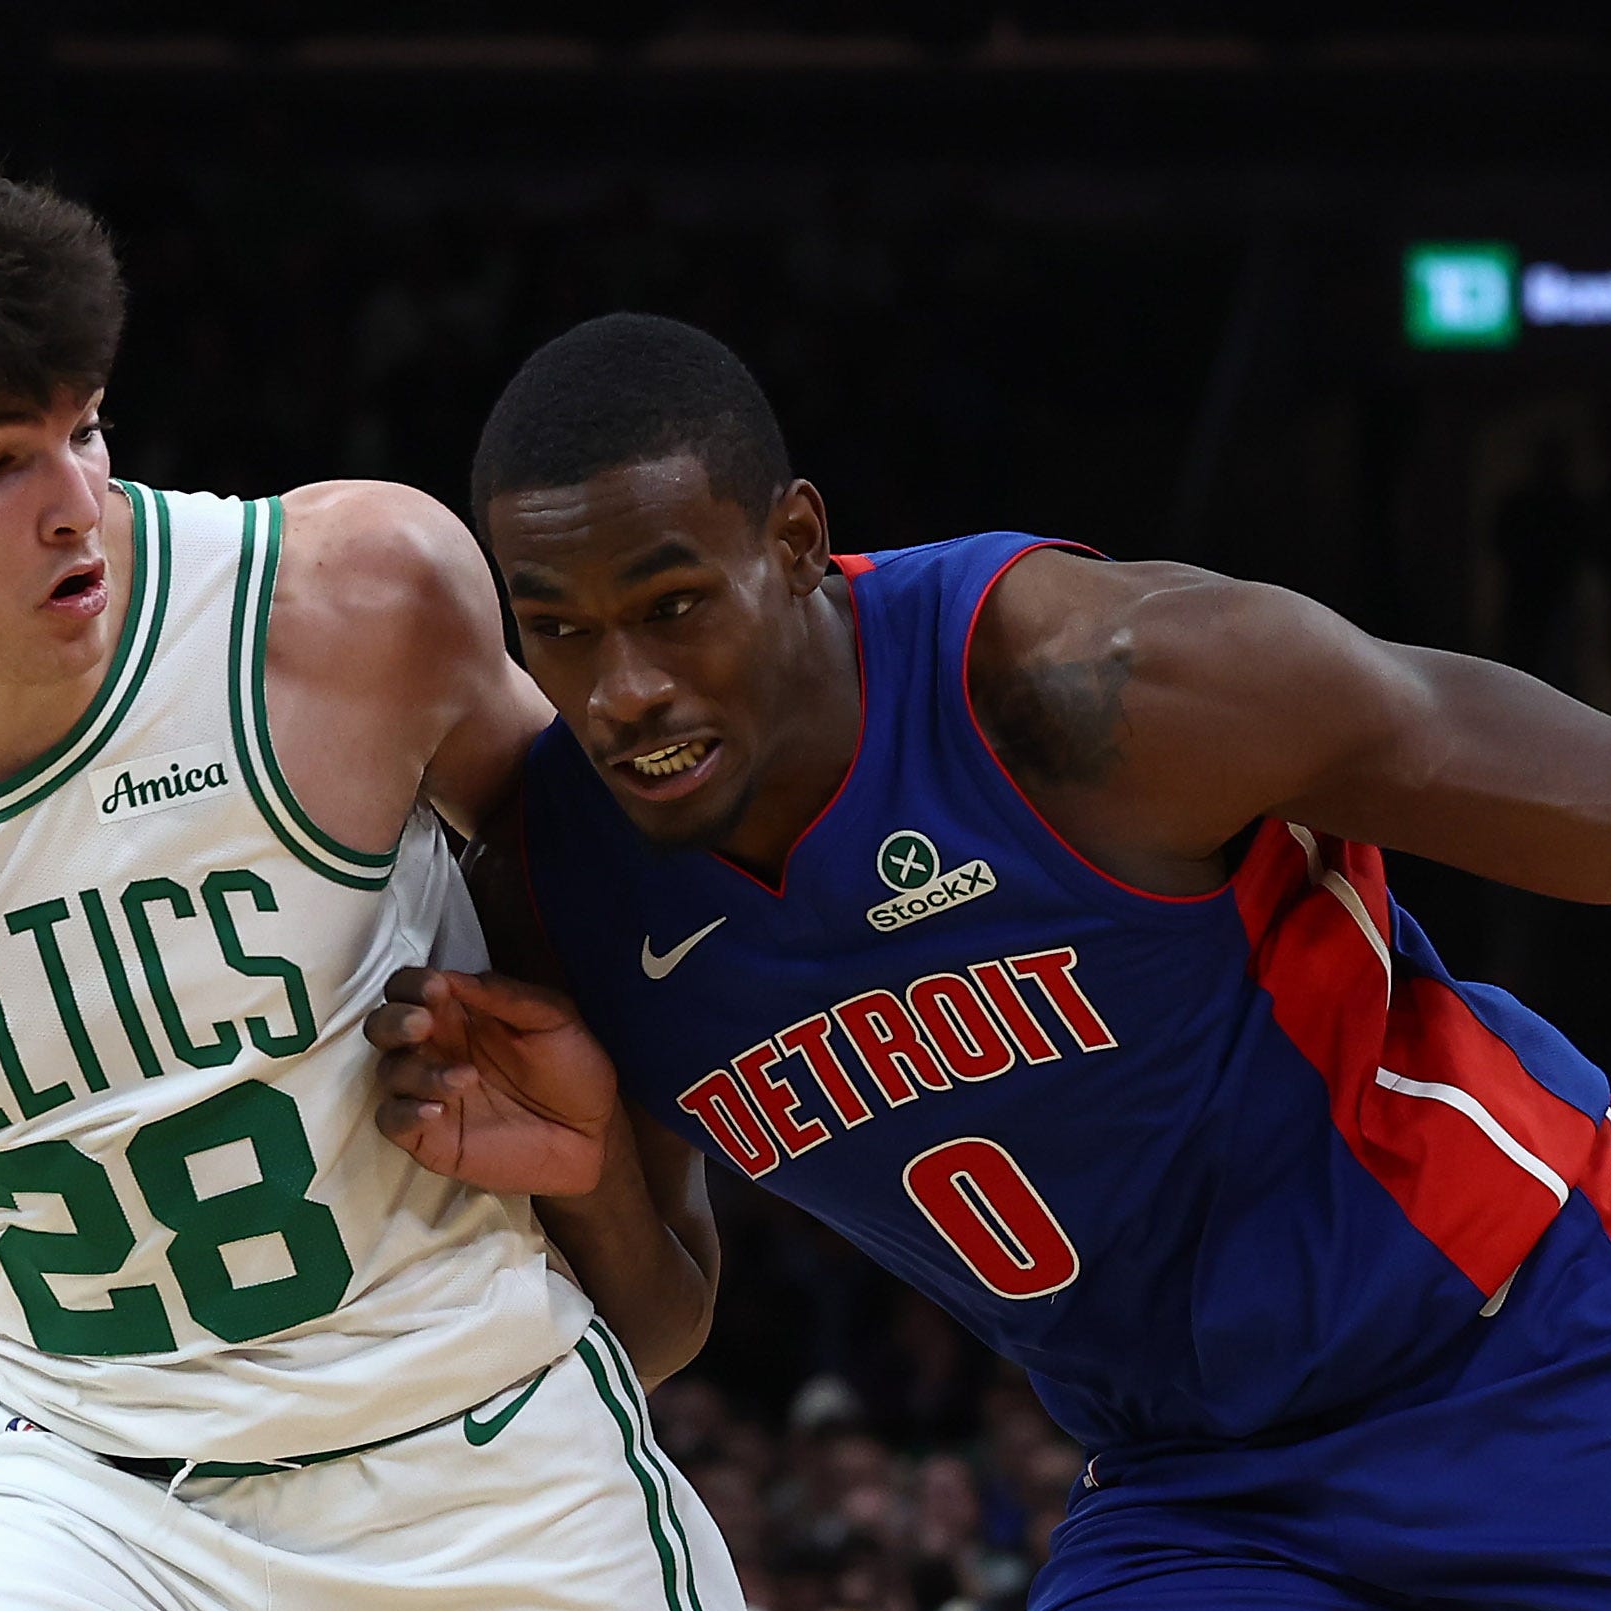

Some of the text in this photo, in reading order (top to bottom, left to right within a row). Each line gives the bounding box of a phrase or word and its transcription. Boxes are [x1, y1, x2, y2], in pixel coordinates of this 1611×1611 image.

[101, 762, 229, 814] Amica
[871, 863, 992, 928] StockX
[676, 946, 1119, 1180] DETROIT
[902, 1136, 1080, 1300] 0
